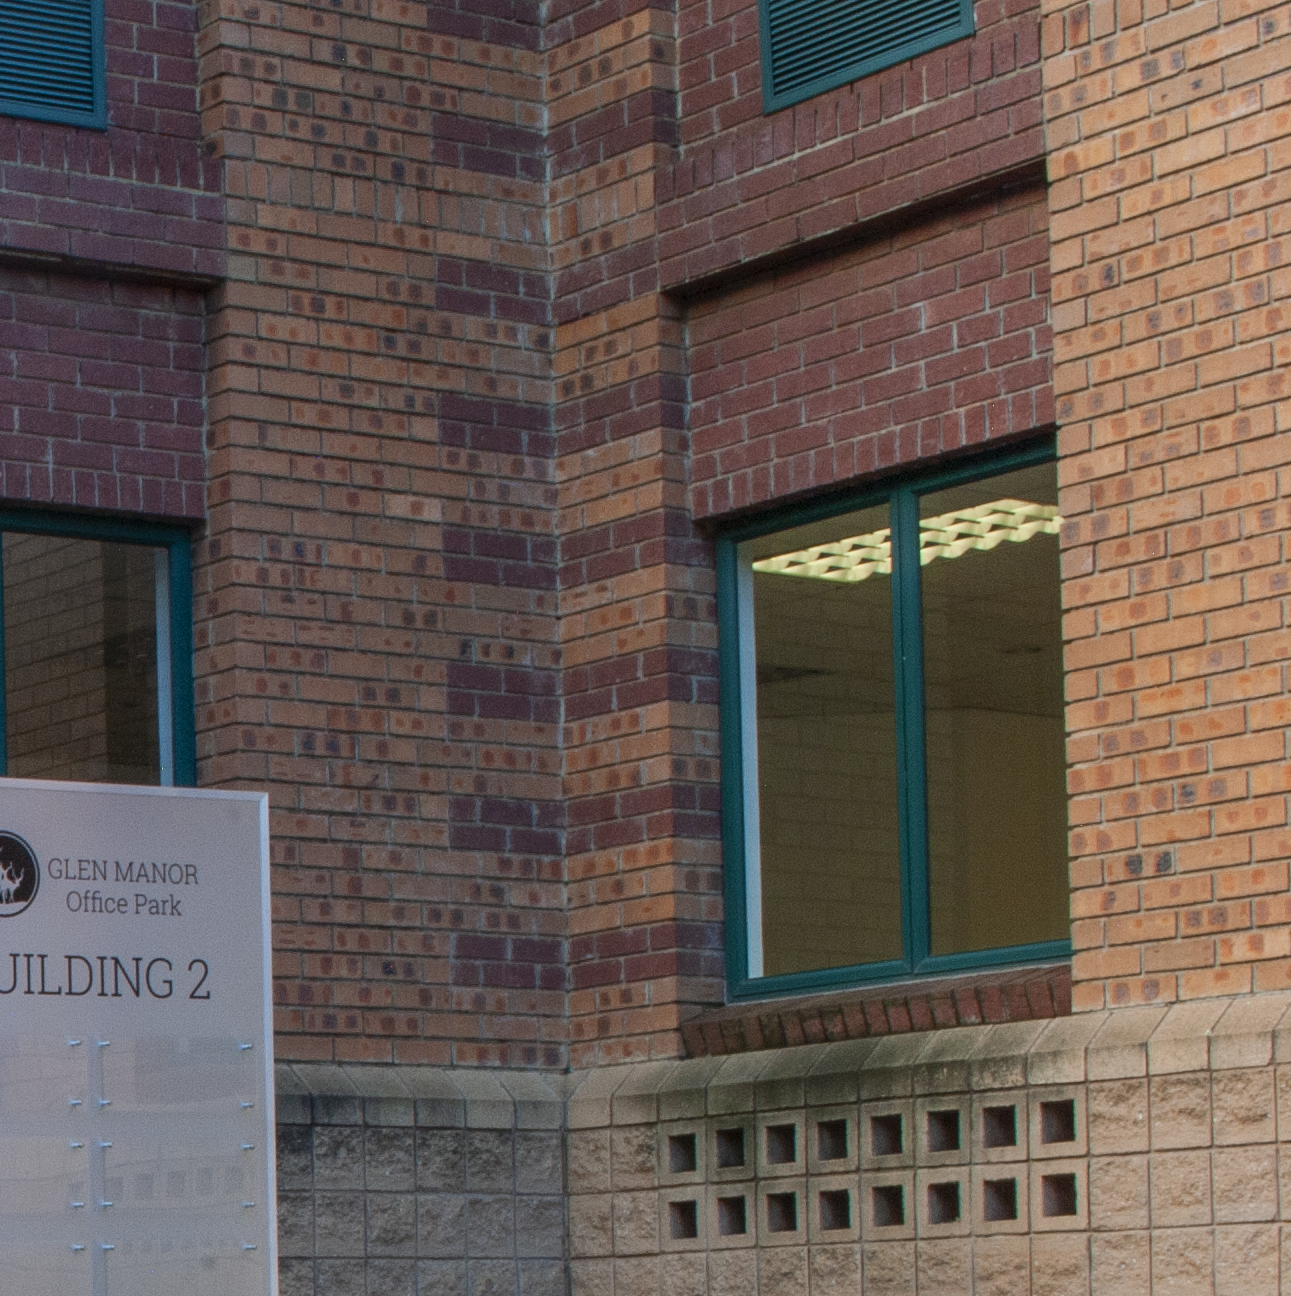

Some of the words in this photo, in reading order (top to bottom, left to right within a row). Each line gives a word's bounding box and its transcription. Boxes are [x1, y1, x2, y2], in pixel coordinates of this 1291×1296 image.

[48, 857, 107, 881] GLEN
[114, 861, 199, 885] MANOR
[66, 891, 128, 915] Office
[134, 894, 183, 916] Park
[187, 959, 211, 999] 2
